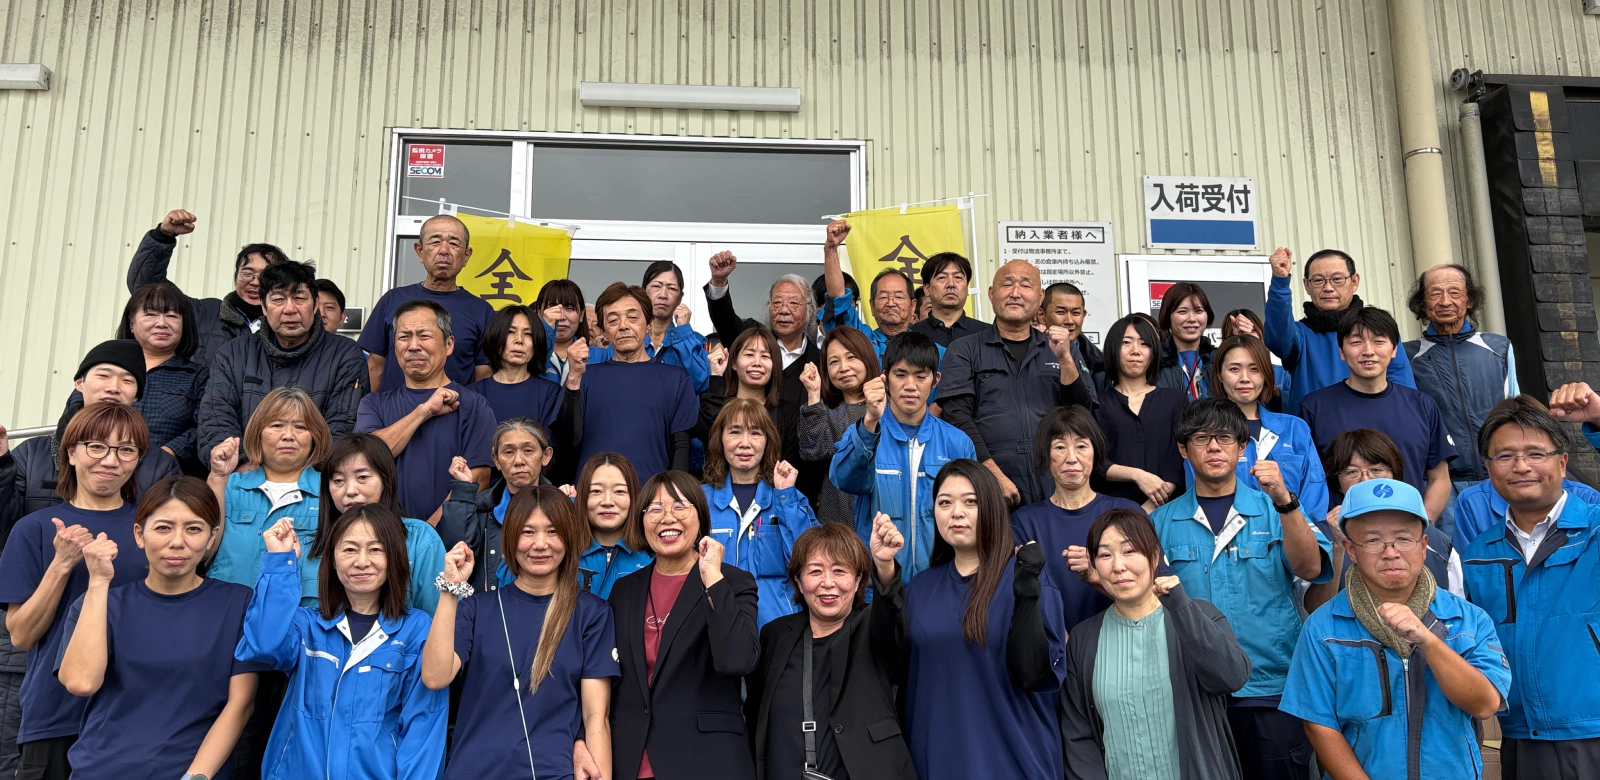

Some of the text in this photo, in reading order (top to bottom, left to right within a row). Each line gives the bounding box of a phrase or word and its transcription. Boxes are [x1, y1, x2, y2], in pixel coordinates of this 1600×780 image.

[410, 166, 442, 175] SECOM
[1150, 183, 1251, 214] 入荷受付
[1014, 229, 1097, 240] 納入業者様へ
[878, 235, 928, 285] 全
[474, 248, 533, 304] 全
